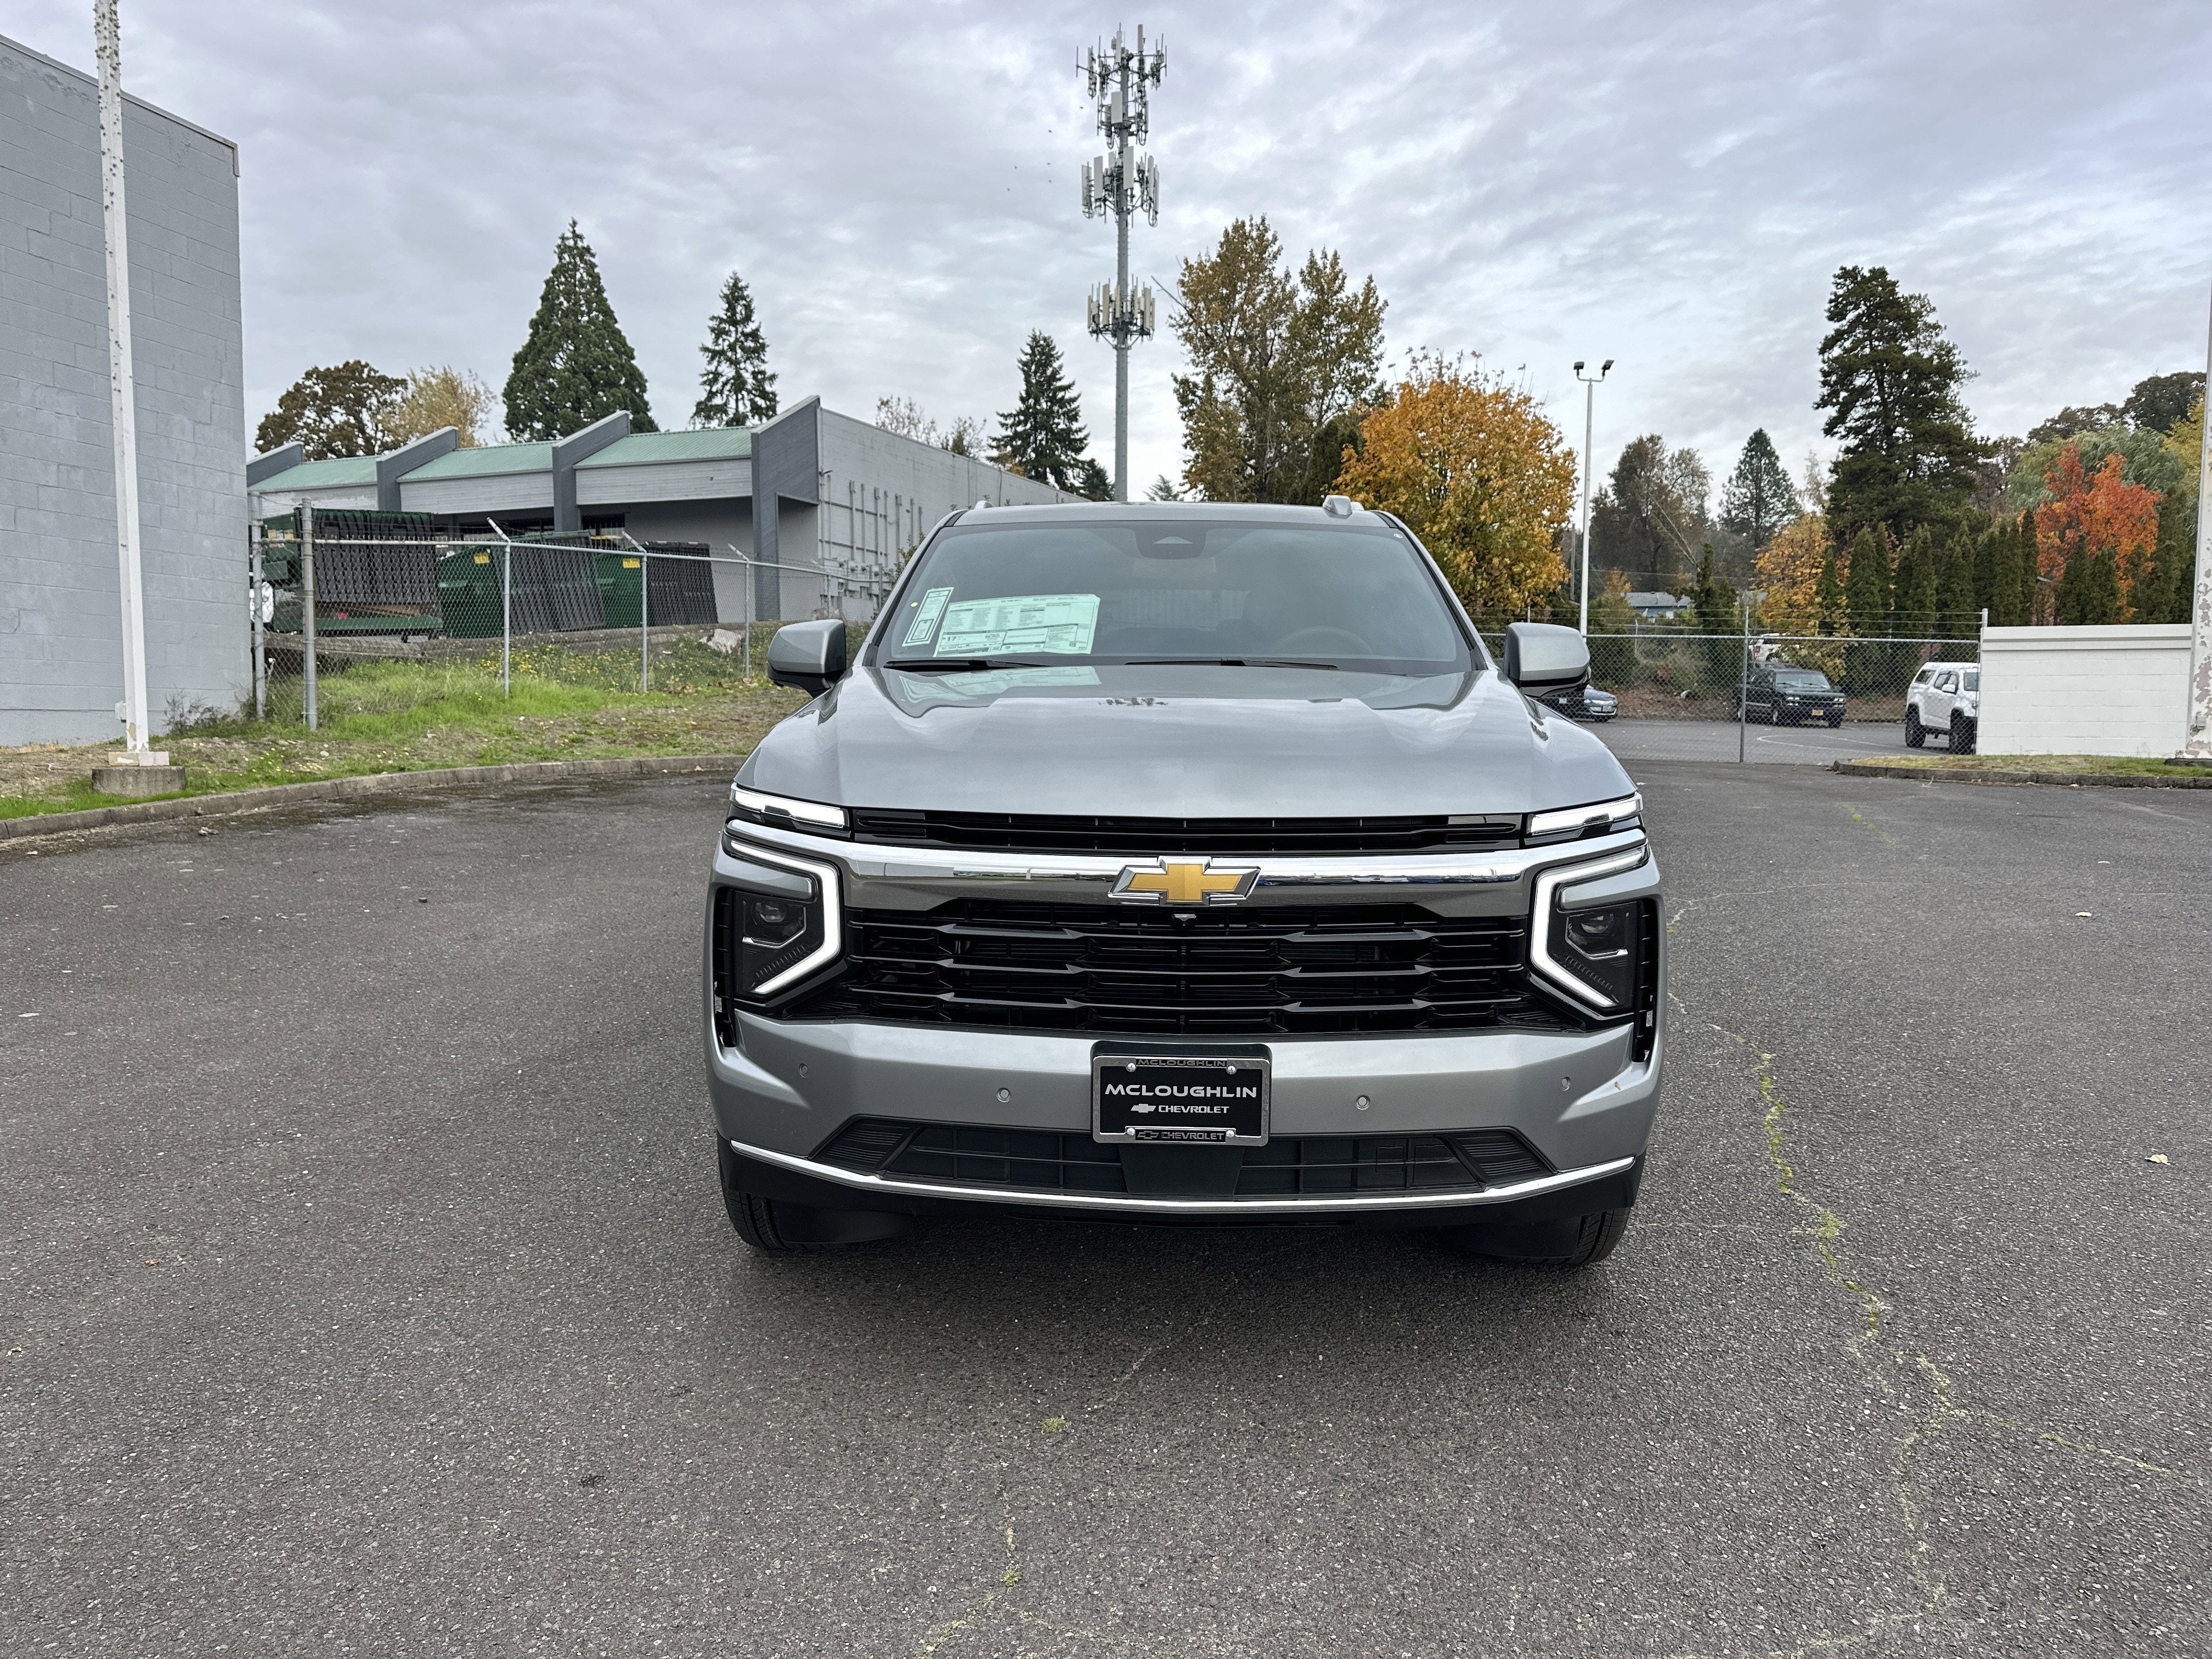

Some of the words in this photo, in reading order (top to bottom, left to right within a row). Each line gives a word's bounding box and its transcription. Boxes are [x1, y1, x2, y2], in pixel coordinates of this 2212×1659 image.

[1104, 1084, 1257, 1098] MCLOUGHLIN
[1158, 1105, 1229, 1114] CHEVROLET
[1161, 1132, 1224, 1140] CHEVROLET
